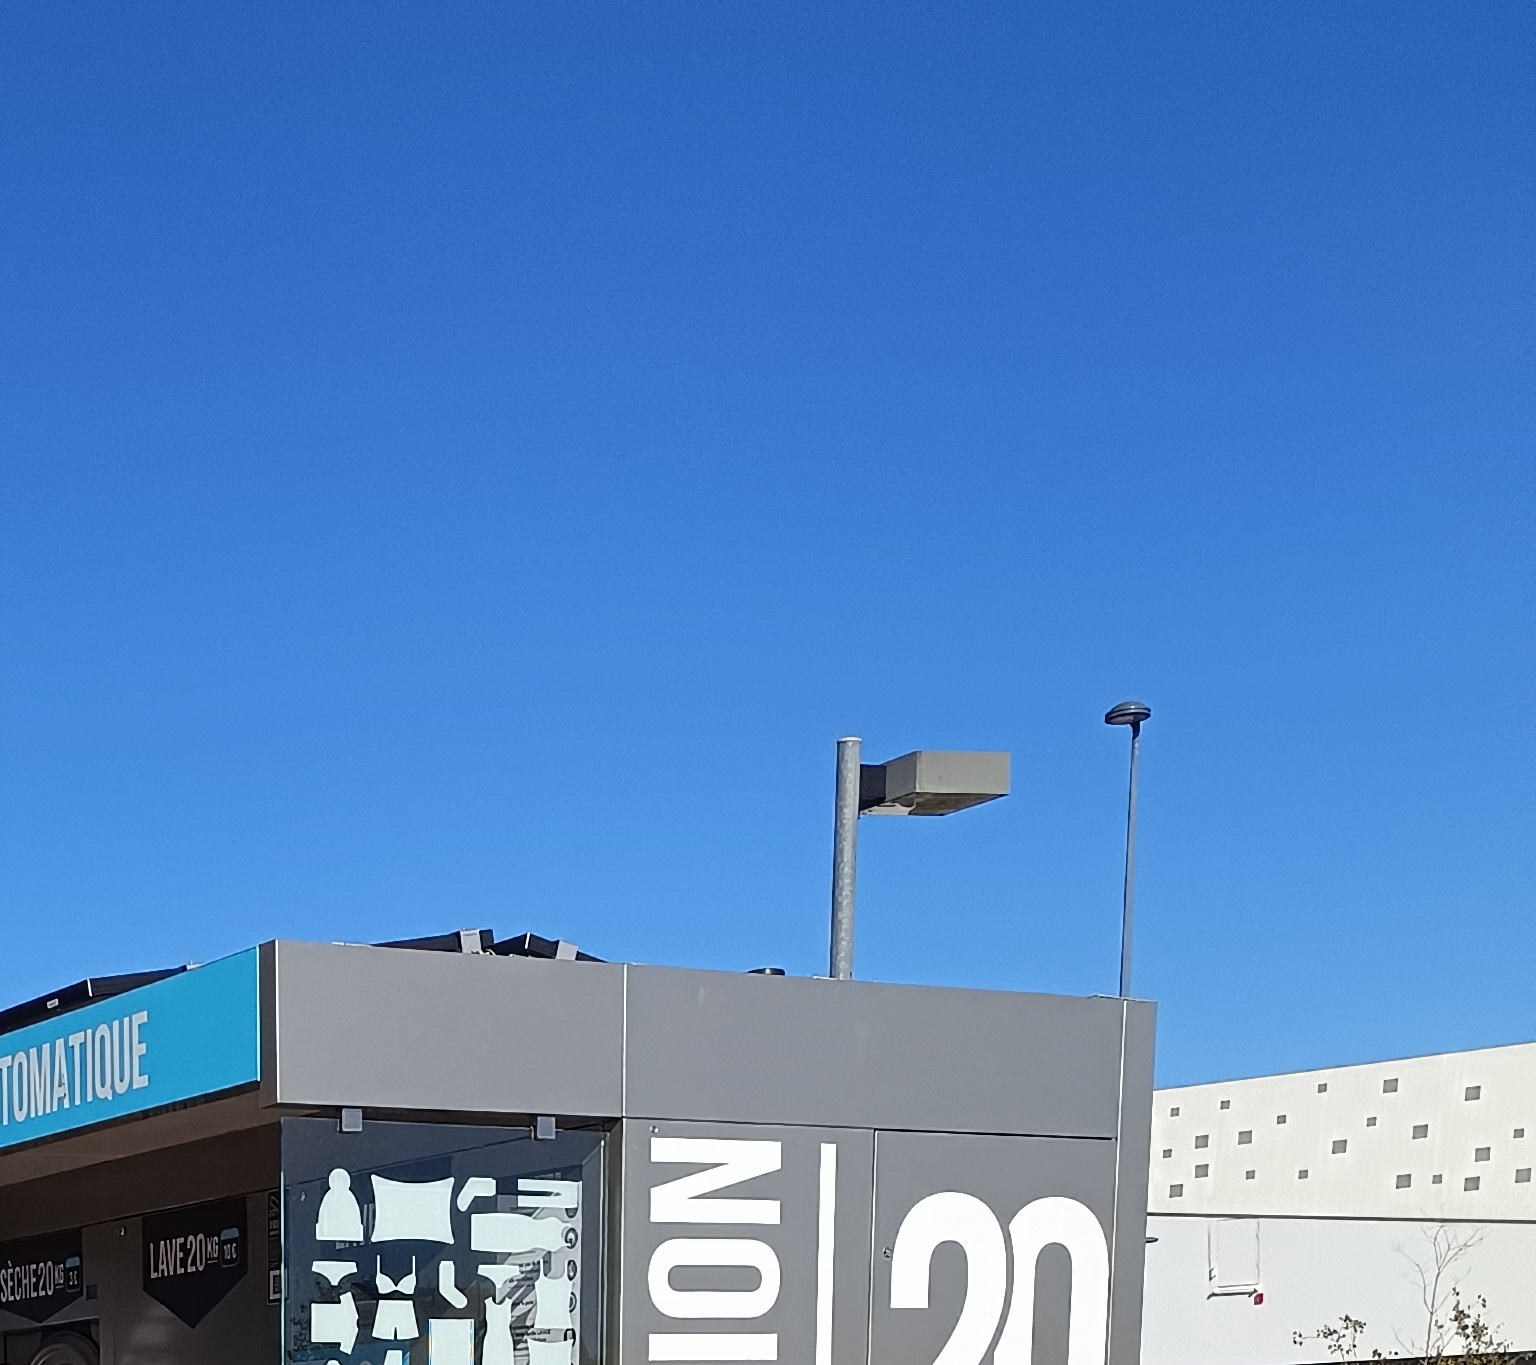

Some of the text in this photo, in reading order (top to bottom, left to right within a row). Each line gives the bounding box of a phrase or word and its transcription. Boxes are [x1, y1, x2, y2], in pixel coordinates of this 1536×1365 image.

[150, 1236, 185, 1279] LAVE
[187, 1233, 206, 1273] 20
[0, 1259, 38, 1303] SÈCHE
[38, 1260, 54, 1297] 20
